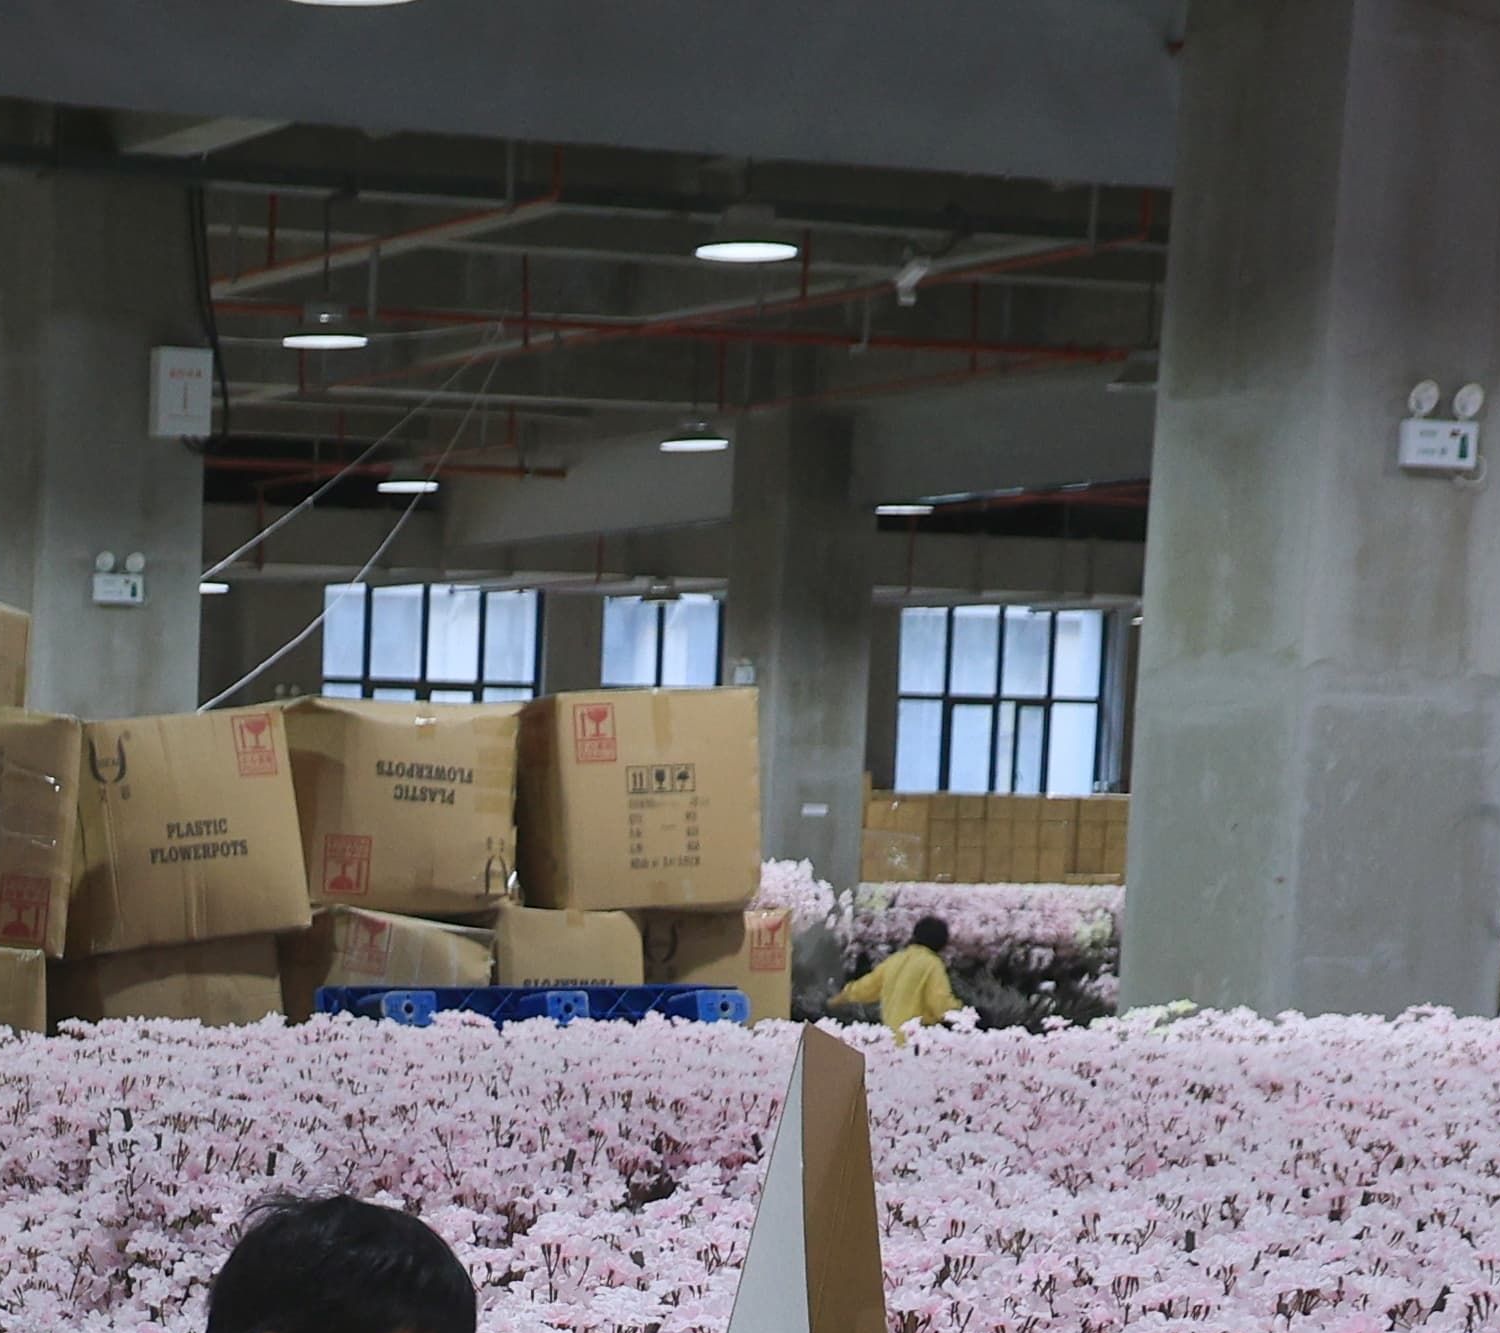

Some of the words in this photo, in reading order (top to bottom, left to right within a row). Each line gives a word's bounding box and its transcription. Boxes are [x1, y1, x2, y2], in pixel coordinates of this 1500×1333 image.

[375, 760, 474, 784] FLOWERPOTS
[393, 784, 456, 805] PLASTIC
[165, 818, 228, 839] PLASTIC
[149, 839, 249, 864] FLOWERPOTS
